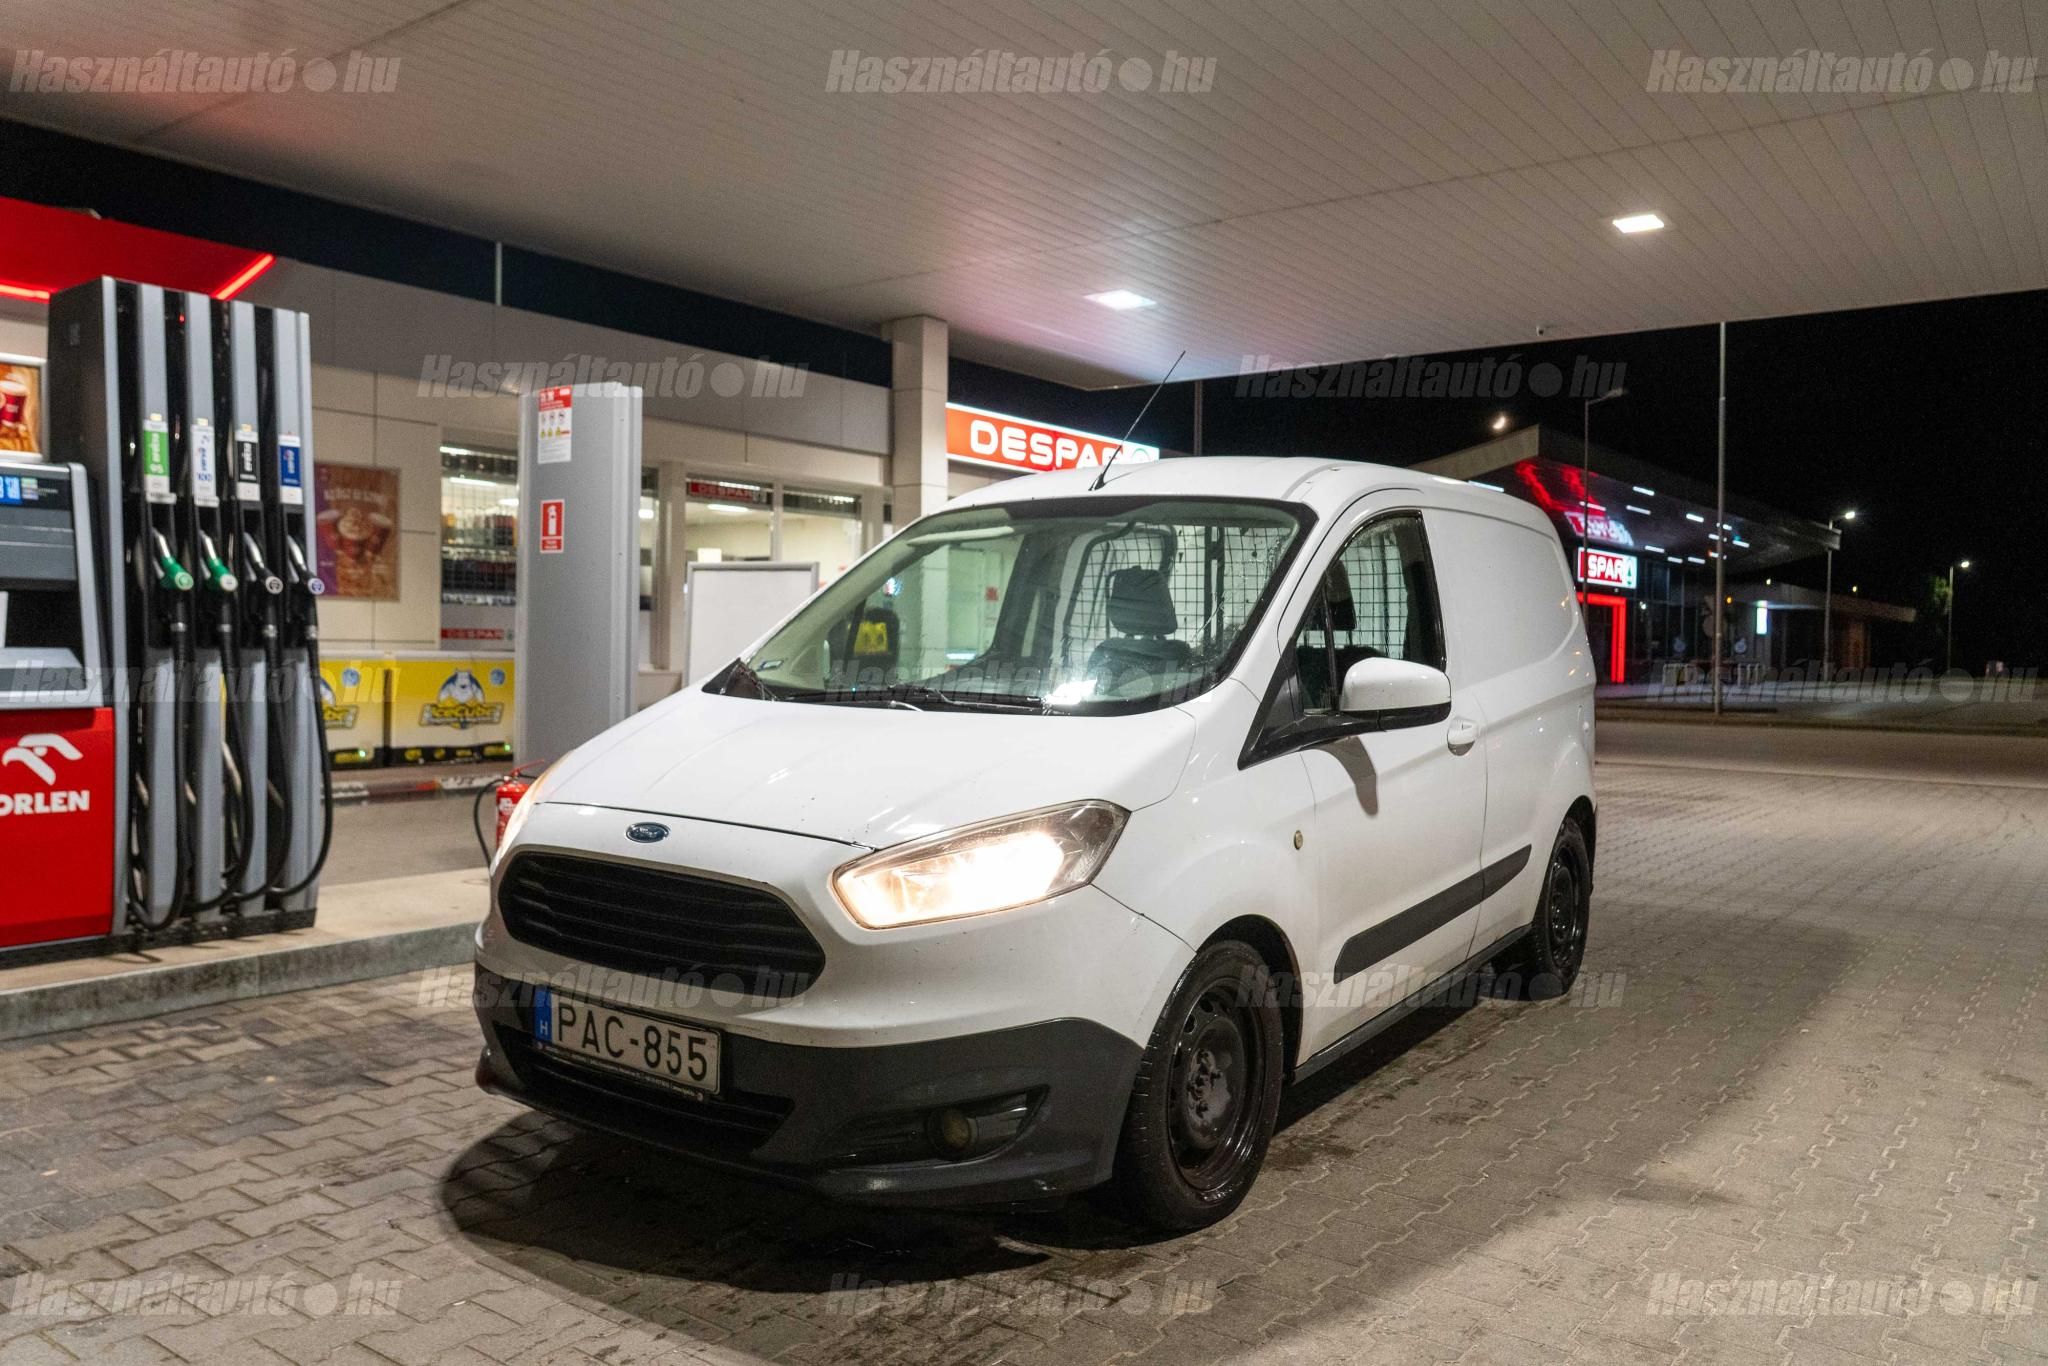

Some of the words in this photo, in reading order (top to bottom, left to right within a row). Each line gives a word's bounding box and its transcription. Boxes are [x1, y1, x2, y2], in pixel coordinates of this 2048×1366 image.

[1588, 554, 1623, 582] SPAR
[539, 1021, 548, 1036] H
[558, 1002, 708, 1081] PAC-855
